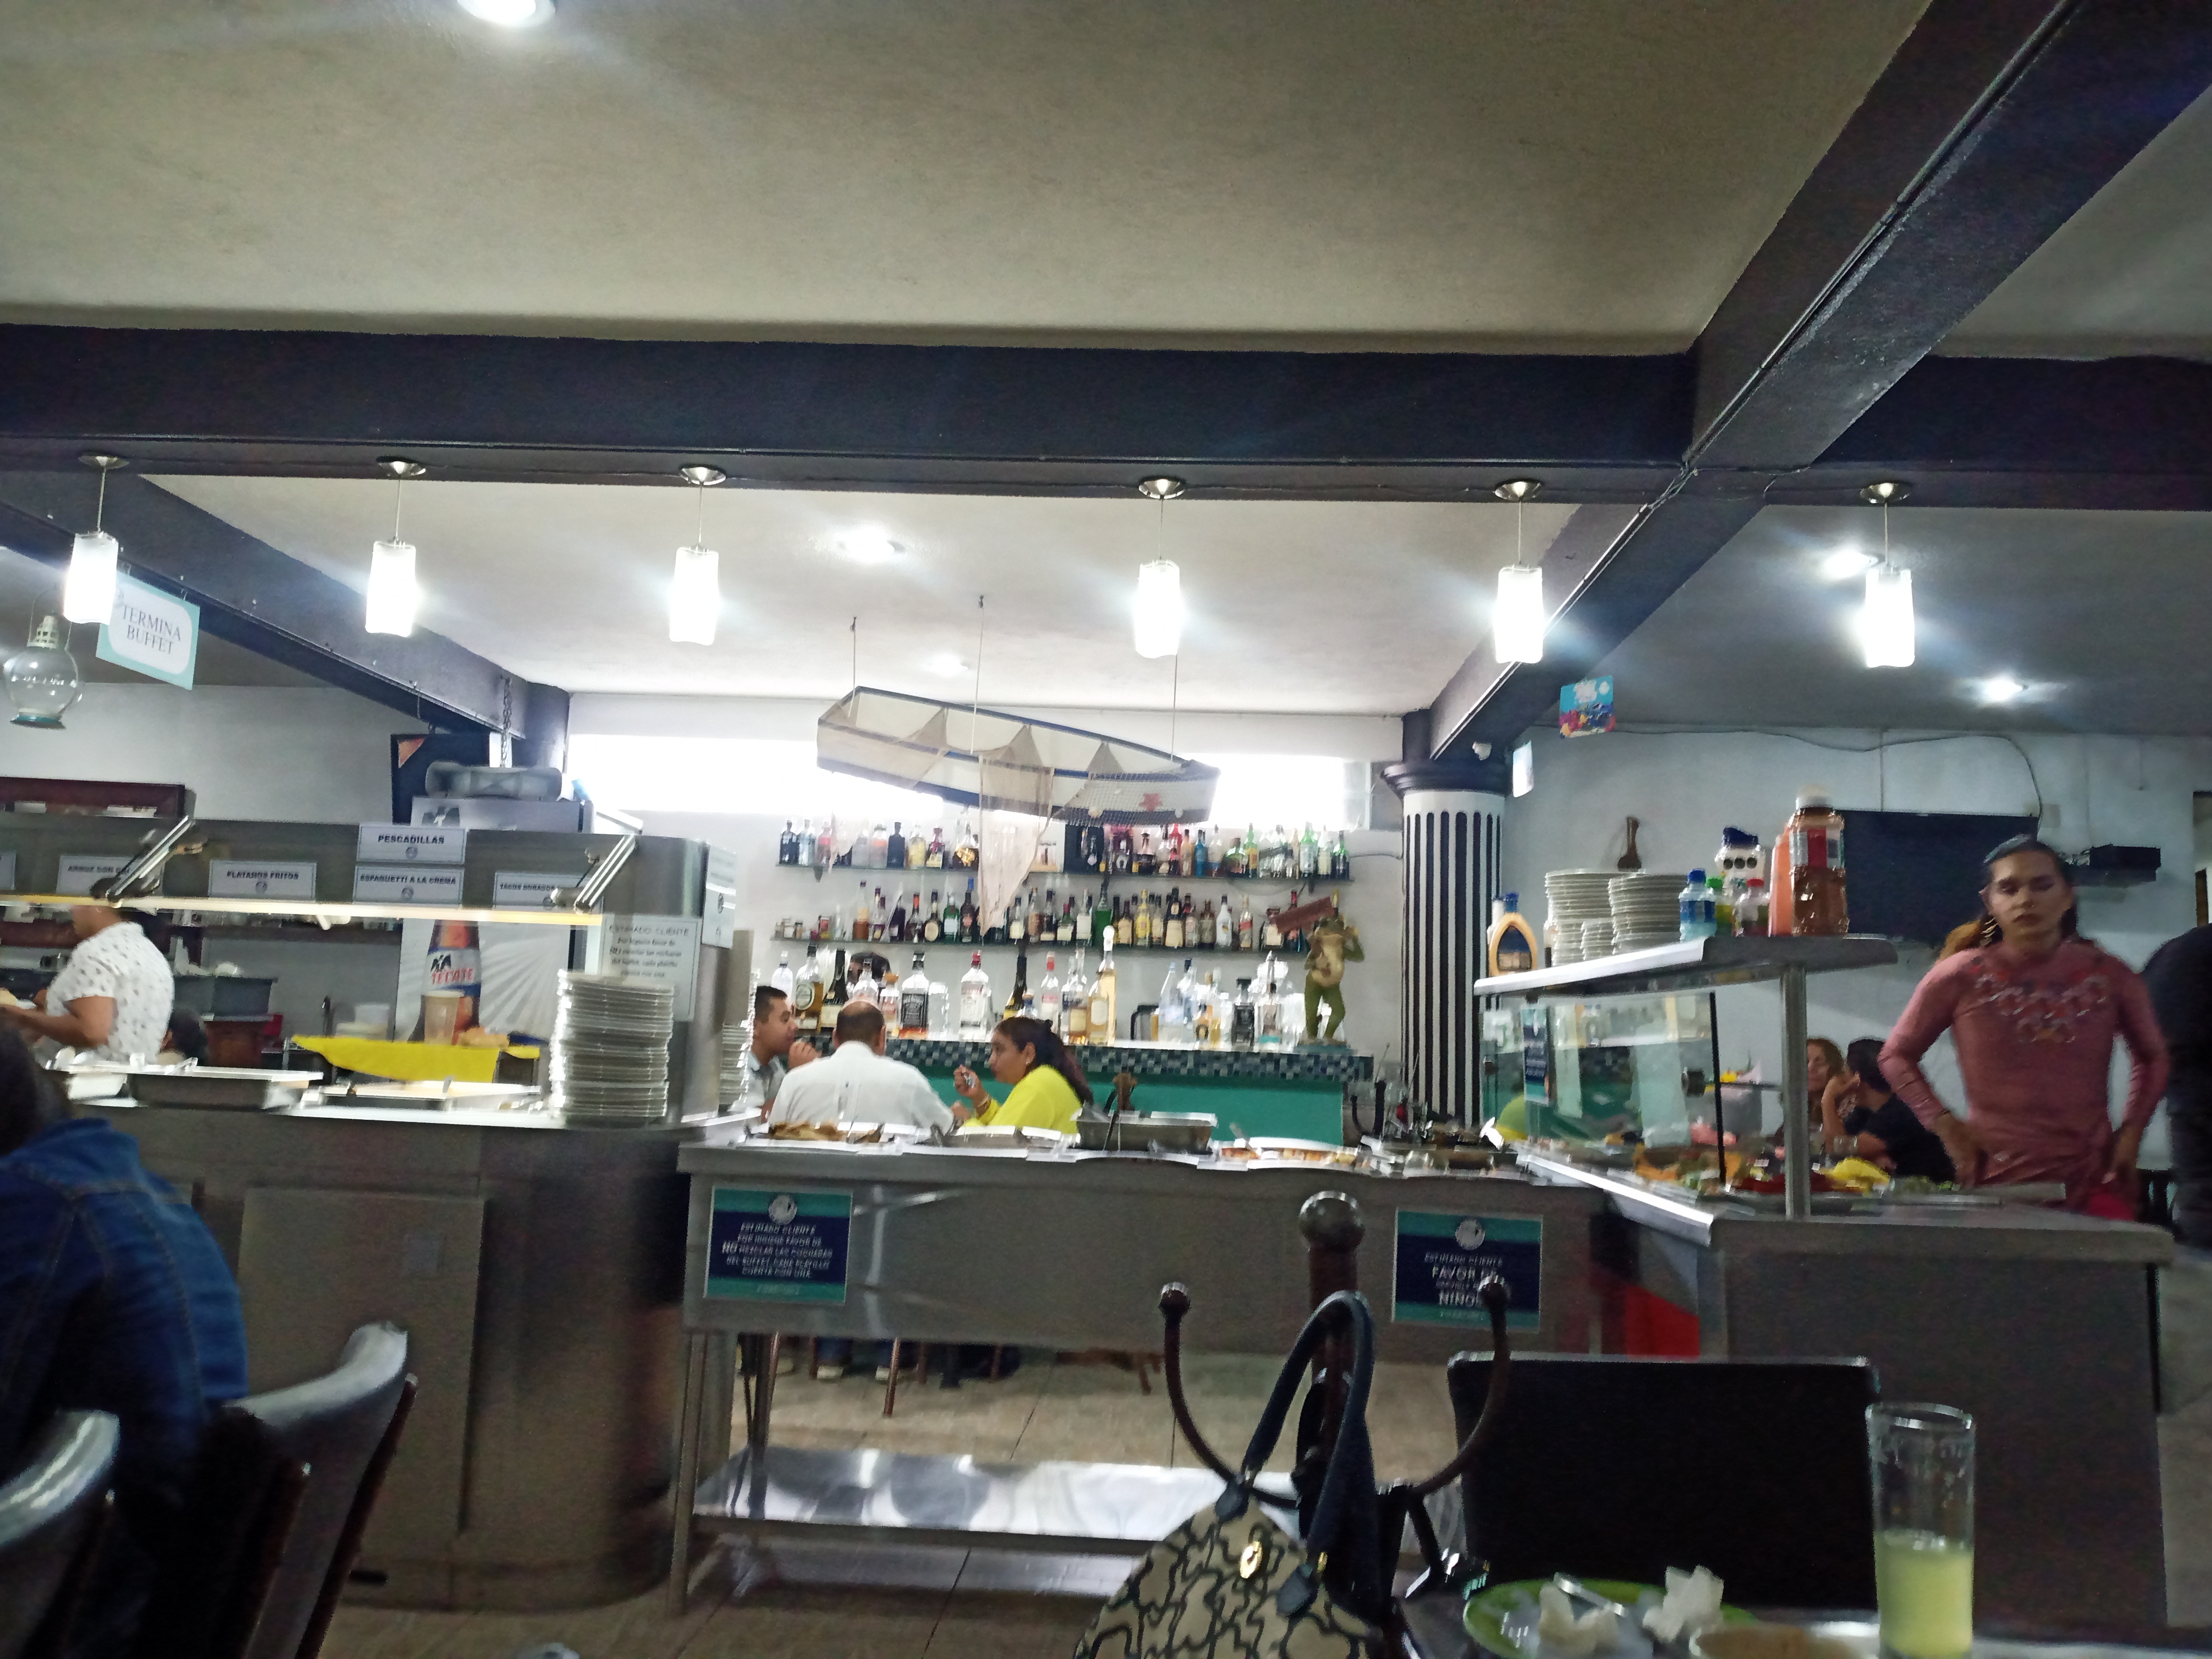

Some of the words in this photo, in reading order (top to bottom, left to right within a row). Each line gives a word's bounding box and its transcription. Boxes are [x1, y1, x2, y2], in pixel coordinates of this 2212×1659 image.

[122, 605, 181, 641] TERMINA
[127, 624, 174, 655] BUFFET
[378, 834, 445, 844] PESCADILLAS
[432, 968, 473, 984] TECATE
